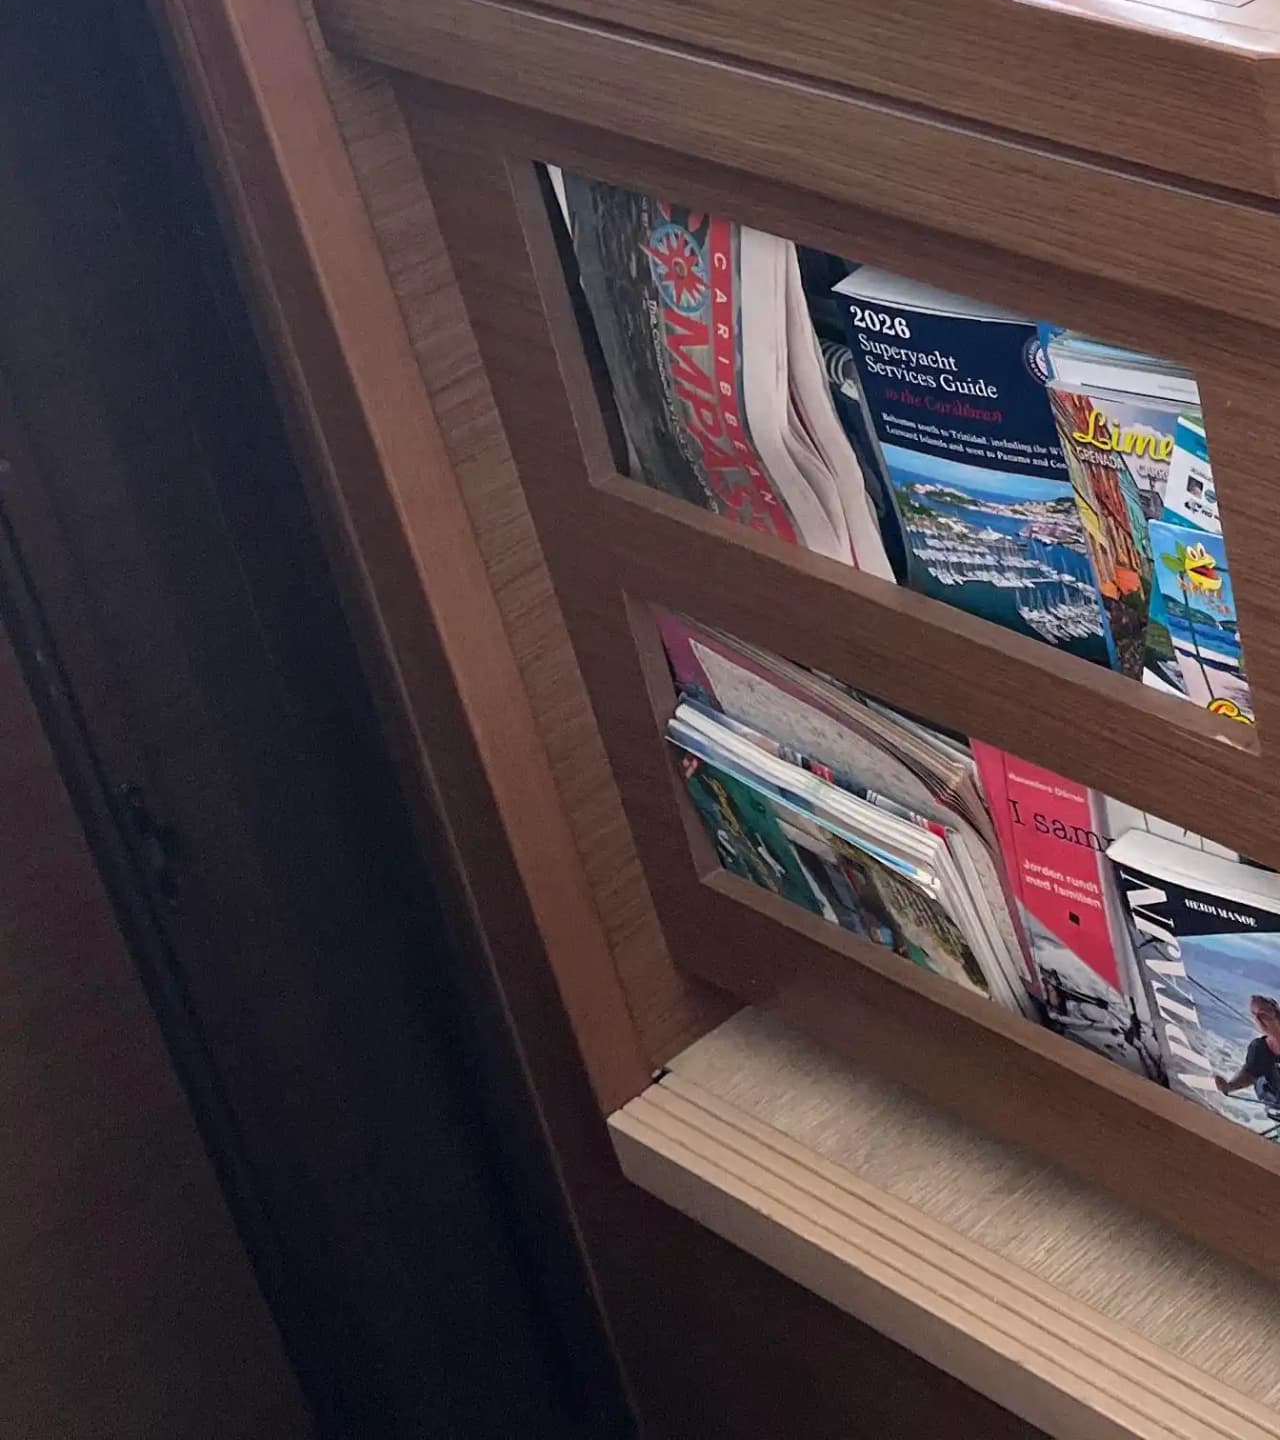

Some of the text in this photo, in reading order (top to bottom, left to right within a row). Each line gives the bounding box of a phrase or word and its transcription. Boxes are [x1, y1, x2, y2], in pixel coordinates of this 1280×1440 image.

[850, 305, 911, 339] 2026
[858, 333, 959, 372] Superyacht
[712, 252, 777, 506] CARIBBEAN
[865, 355, 999, 399] Services Guide
[900, 388, 924, 407] the
[925, 394, 1004, 423] Caribbean
[990, 437, 1033, 455] including
[1033, 444, 1048, 455] the
[1072, 410, 1175, 461] Lime
[949, 441, 964, 453] and
[996, 450, 1031, 465] Panama
[1032, 456, 1049, 468] and
[1076, 447, 1126, 471] GRENADA
[1137, 464, 1170, 482] CARR
[1007, 798, 1025, 826] I
[1023, 858, 1099, 895] Jorden rundt
[1025, 874, 1102, 909] med familien
[1184, 897, 1218, 916] HEIDI
